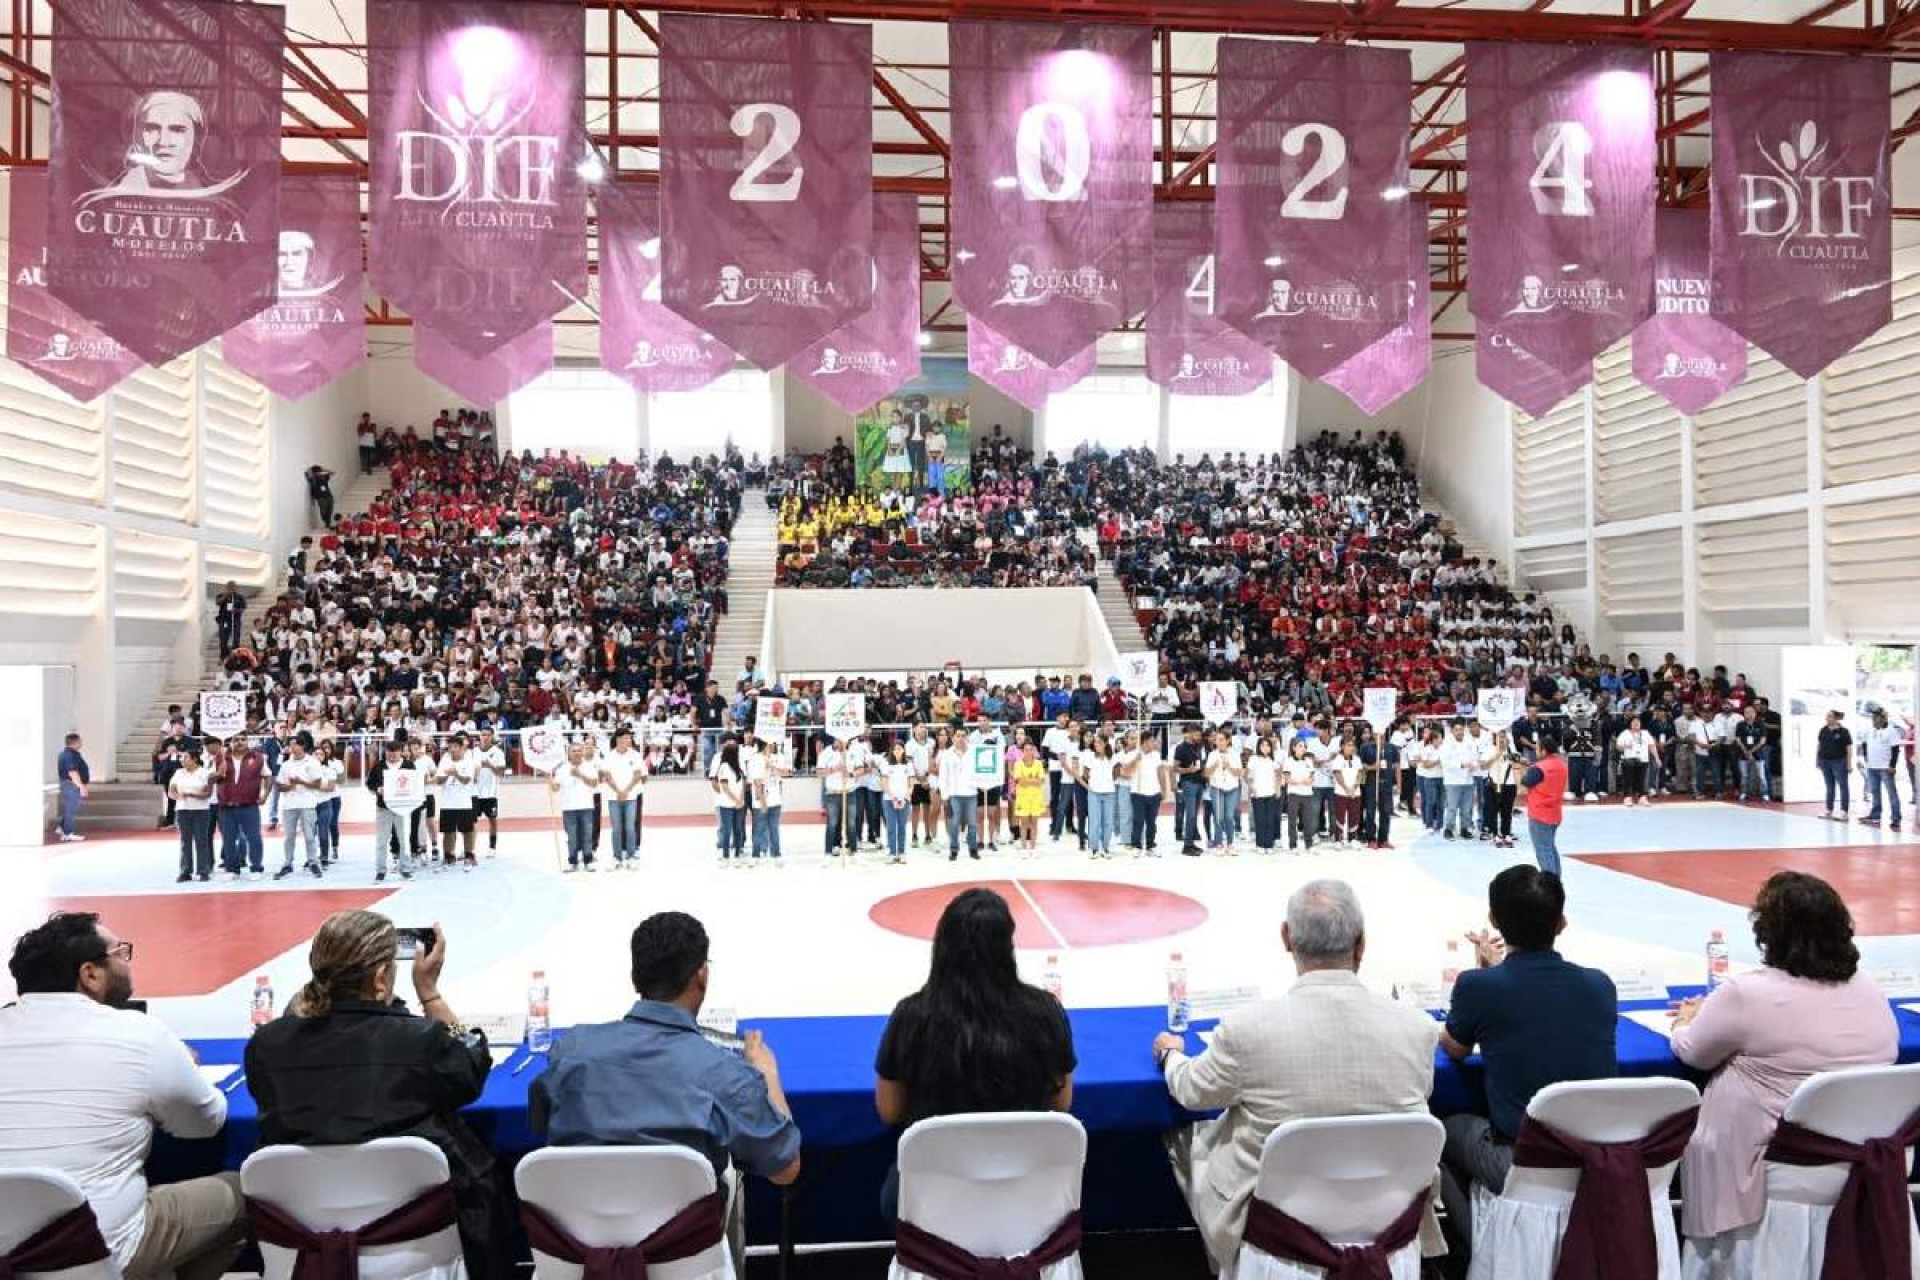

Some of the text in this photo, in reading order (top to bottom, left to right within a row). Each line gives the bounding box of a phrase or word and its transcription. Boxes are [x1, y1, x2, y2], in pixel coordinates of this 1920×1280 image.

[729, 103, 803, 200] 2
[1016, 102, 1090, 200] 0
[394, 130, 559, 206] DIF
[1281, 122, 1348, 219] 2
[1531, 122, 1593, 216] 4
[1738, 173, 1875, 238] DIF
[75, 209, 248, 243] CUAUTLA
[456, 210, 553, 229] CUAUTLA
[112, 237, 206, 252] MORELOS
[1790, 244, 1869, 259] CUAUTLA
[745, 277, 835, 294] CUAUTLA
[1033, 274, 1118, 291] CUAUTLA
[1185, 254, 1215, 315] 4
[1543, 287, 1626, 300] CUAUTLA
[1656, 279, 1712, 295] NUEV
[1294, 289, 1377, 308] CUAUTLA
